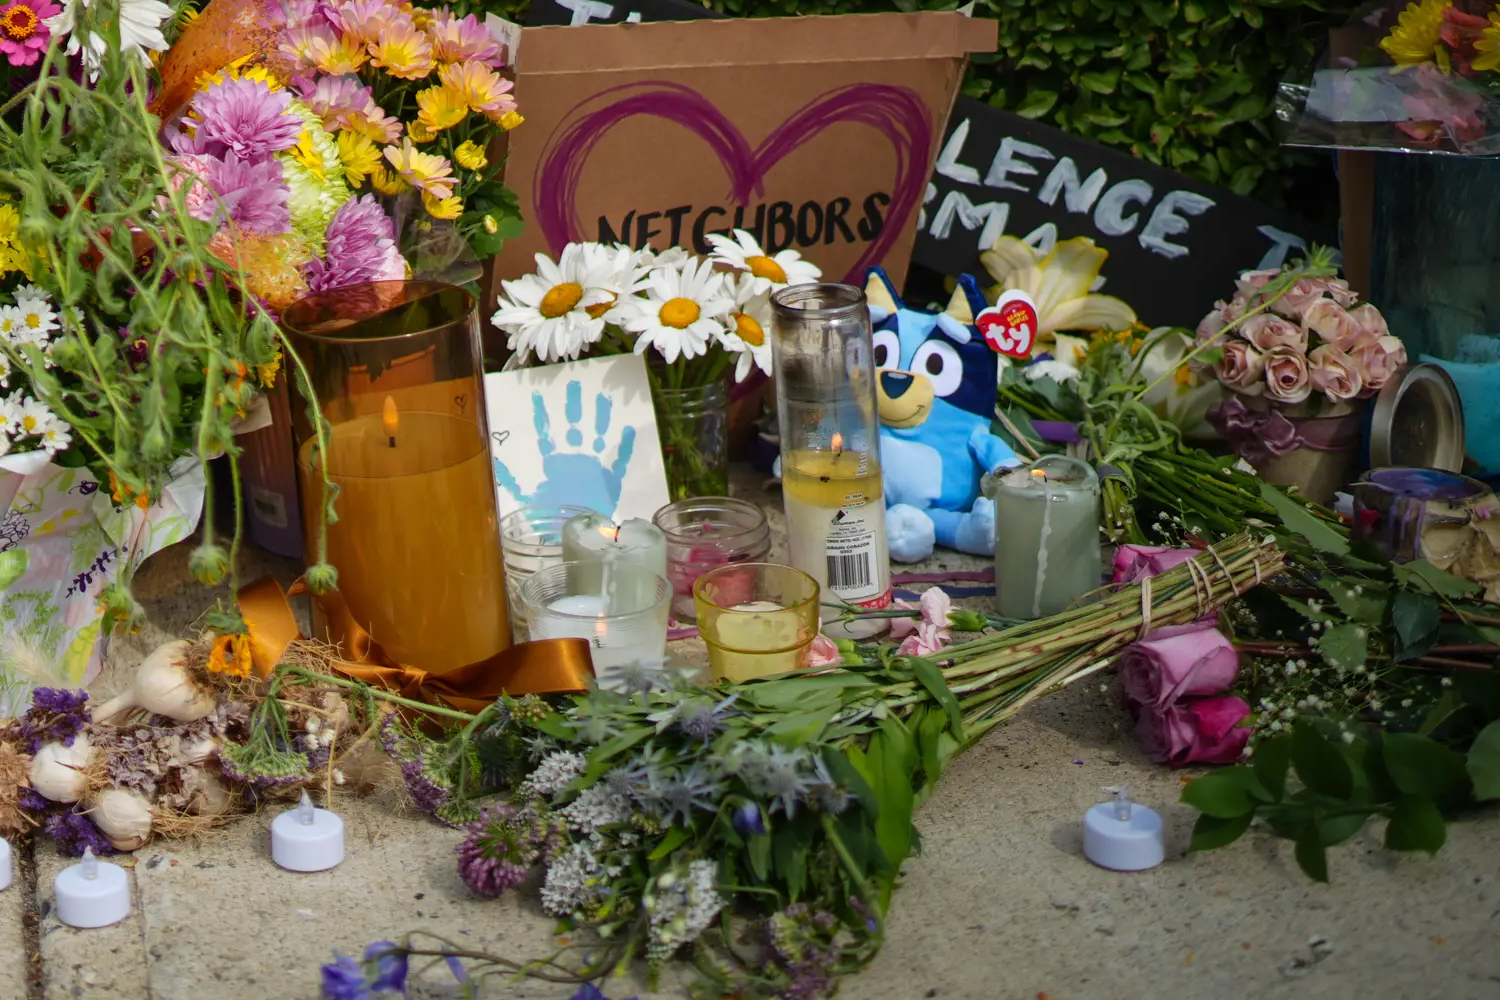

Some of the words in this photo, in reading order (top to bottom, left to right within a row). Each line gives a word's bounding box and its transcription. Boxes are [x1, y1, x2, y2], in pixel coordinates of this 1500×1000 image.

[936, 117, 1216, 260] LENCE
[597, 191, 892, 258] NEIGHBORS
[985, 322, 1031, 355] ty
